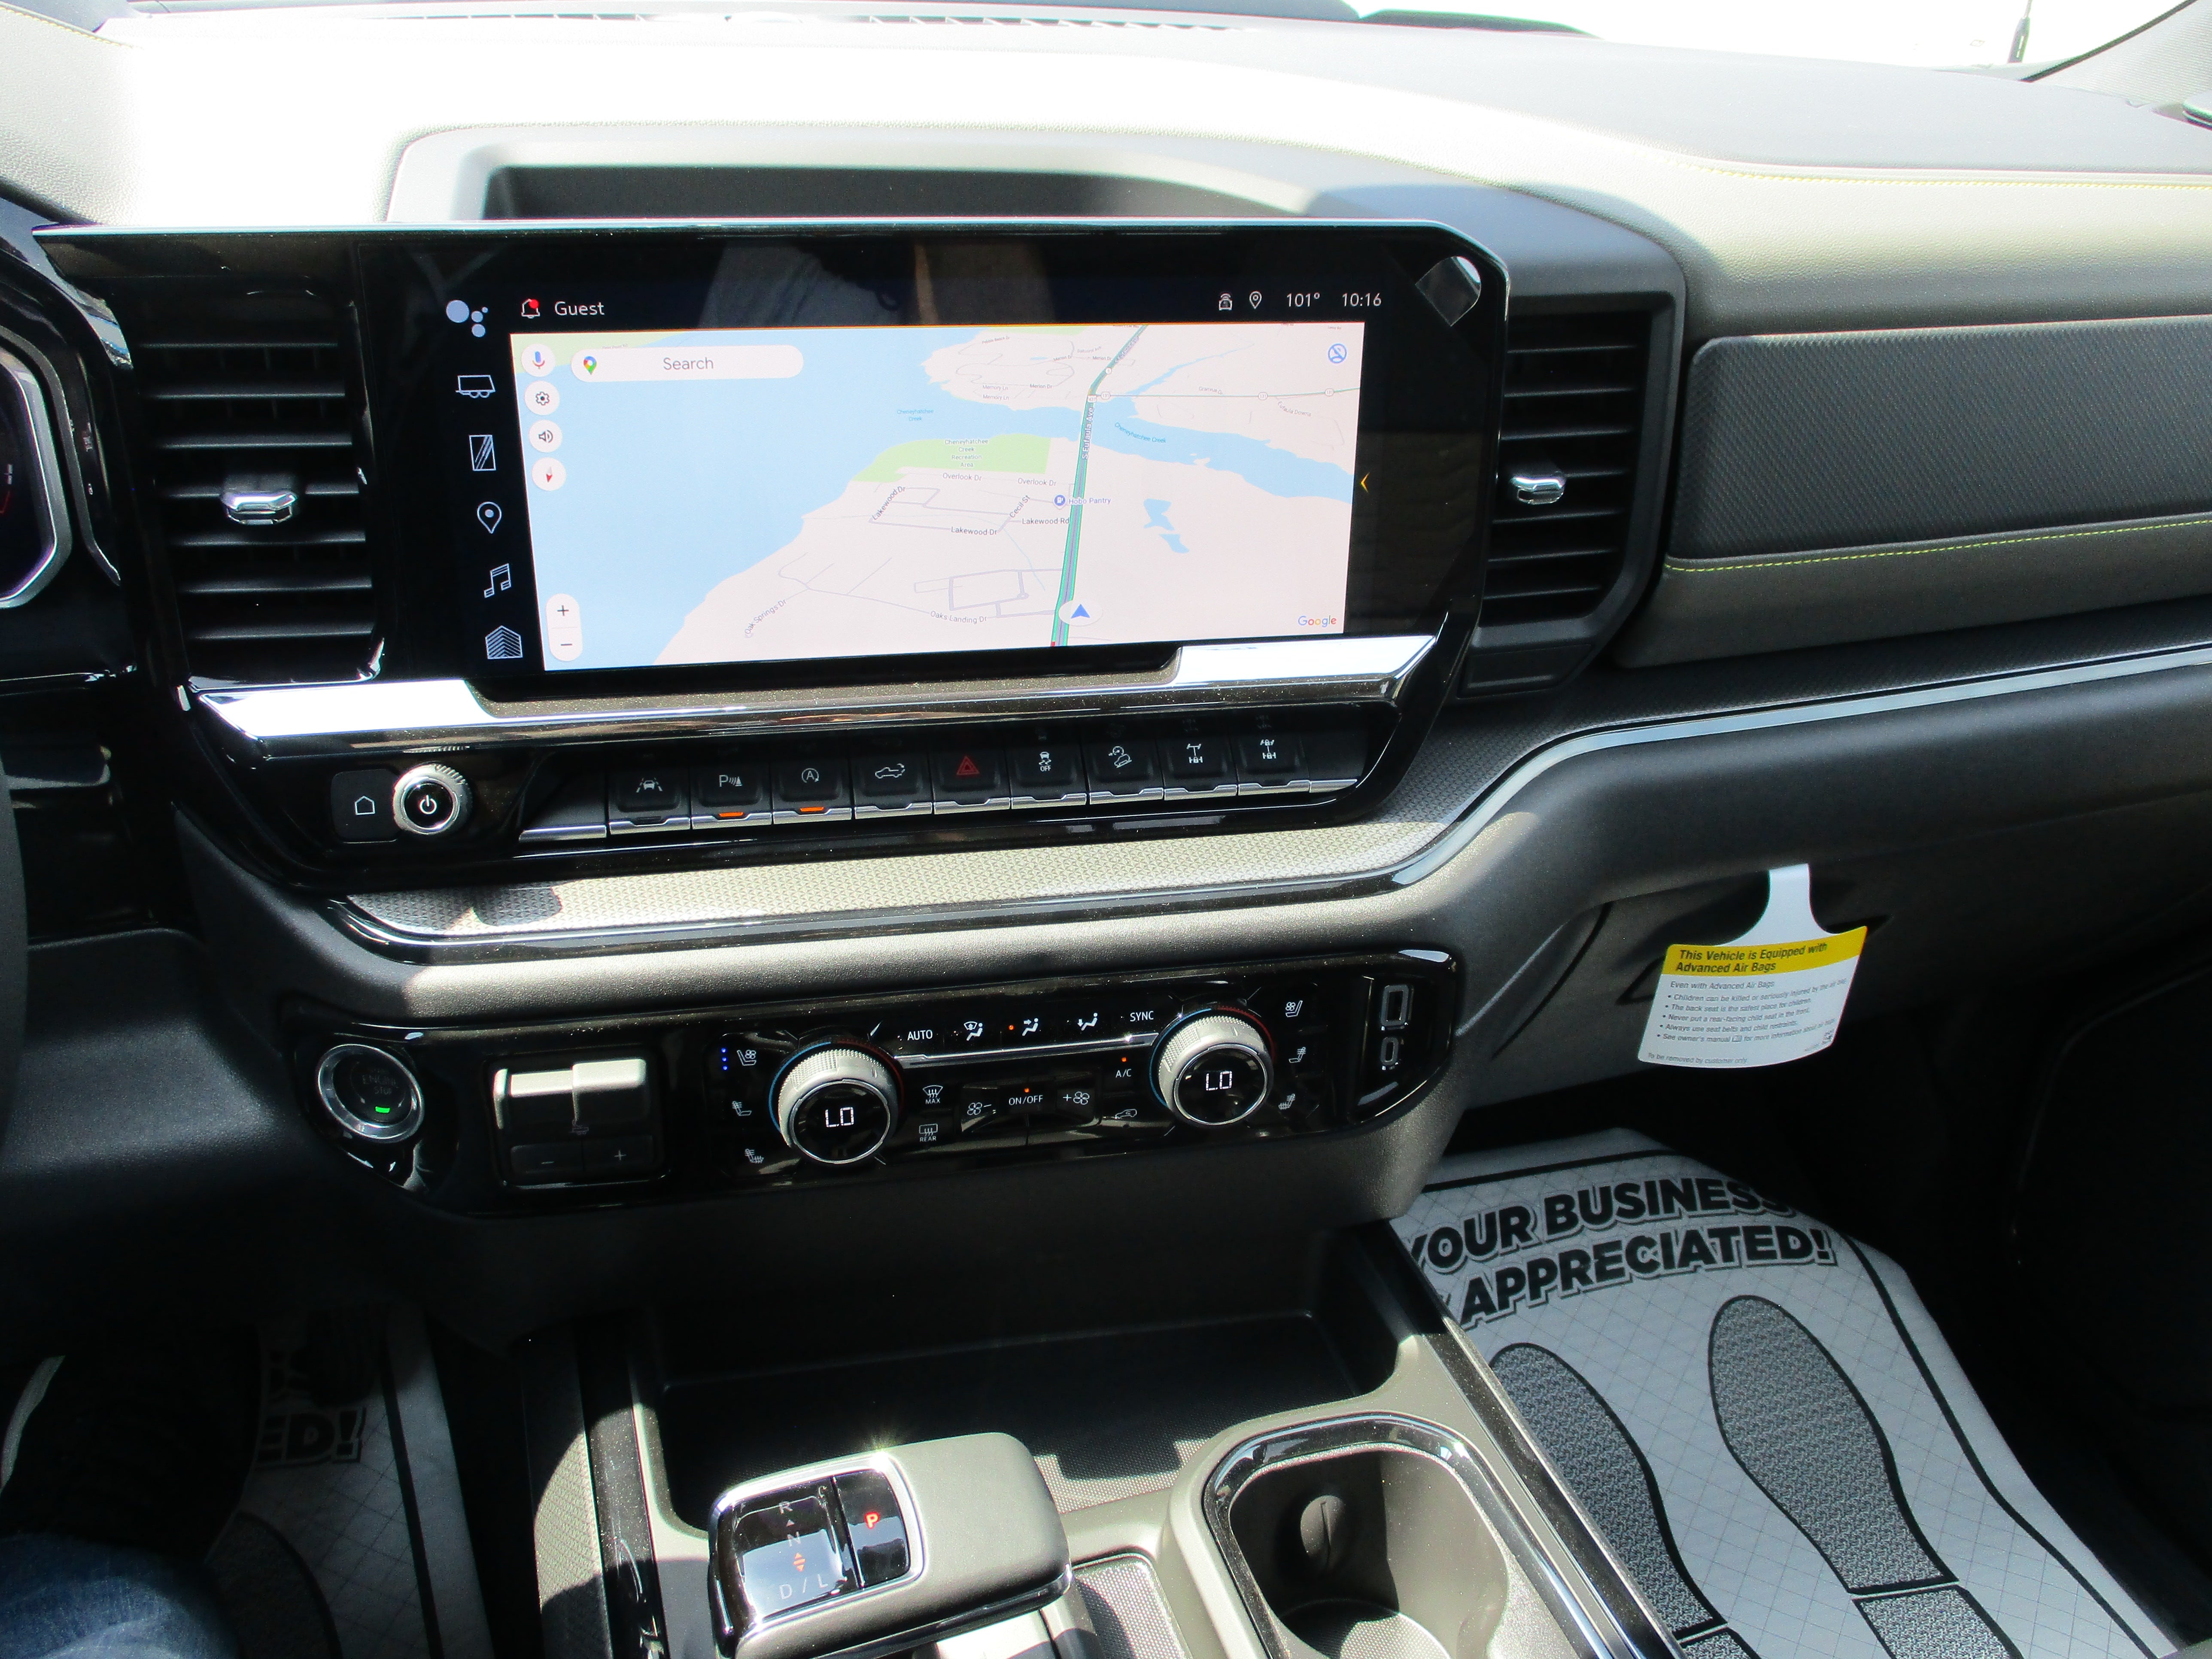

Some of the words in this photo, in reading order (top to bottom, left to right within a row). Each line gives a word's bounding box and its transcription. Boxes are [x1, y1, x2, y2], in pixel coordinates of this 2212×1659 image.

[1342, 292, 1382, 307] 10:16
[554, 301, 605, 316] Guest
[663, 357, 714, 370] Search
[1277, 401, 1294, 414] Eufaula
[1086, 407, 1094, 422] Ave
[1082, 422, 1091, 452] Eufaula
[942, 472, 972, 481] Overlook
[1018, 477, 1047, 486] Overlook
[872, 489, 898, 520] Lakewood
[1009, 501, 1025, 519] Cecil
[1021, 495, 1030, 504] St
[951, 526, 988, 535] Lakewood
[744, 623, 756, 635] Oak
[753, 605, 779, 623] Springs
[778, 599, 787, 608] Dr
[930, 611, 948, 620] Oaks
[949, 615, 977, 624] Landing
[1298, 615, 1337, 627] Google
[719, 775, 729, 787] P
[806, 770, 815, 780] A
[1680, 950, 1702, 960] This
[1707, 951, 1745, 960] Vehicle
[1748, 951, 1757, 960] is
[1760, 945, 1806, 960] Equipped
[1808, 942, 1828, 953] with
[1676, 962, 1732, 972] Advanced
[1732, 962, 1749, 972] Air
[1752, 962, 1776, 973] Bags
[1760, 992, 1788, 1000] seriously
[1129, 1011, 1154, 1022] SYNC
[1665, 1024, 1690, 1032] Always
[907, 1030, 933, 1041] AUTO
[1116, 1068, 1132, 1078] A/C
[1009, 1094, 1044, 1106] ON/OFF
[1460, 1224, 1832, 1327] APPRECIATED!
[779, 1501, 793, 1515] R
[865, 1511, 881, 1529] P
[787, 1531, 802, 1547] N
